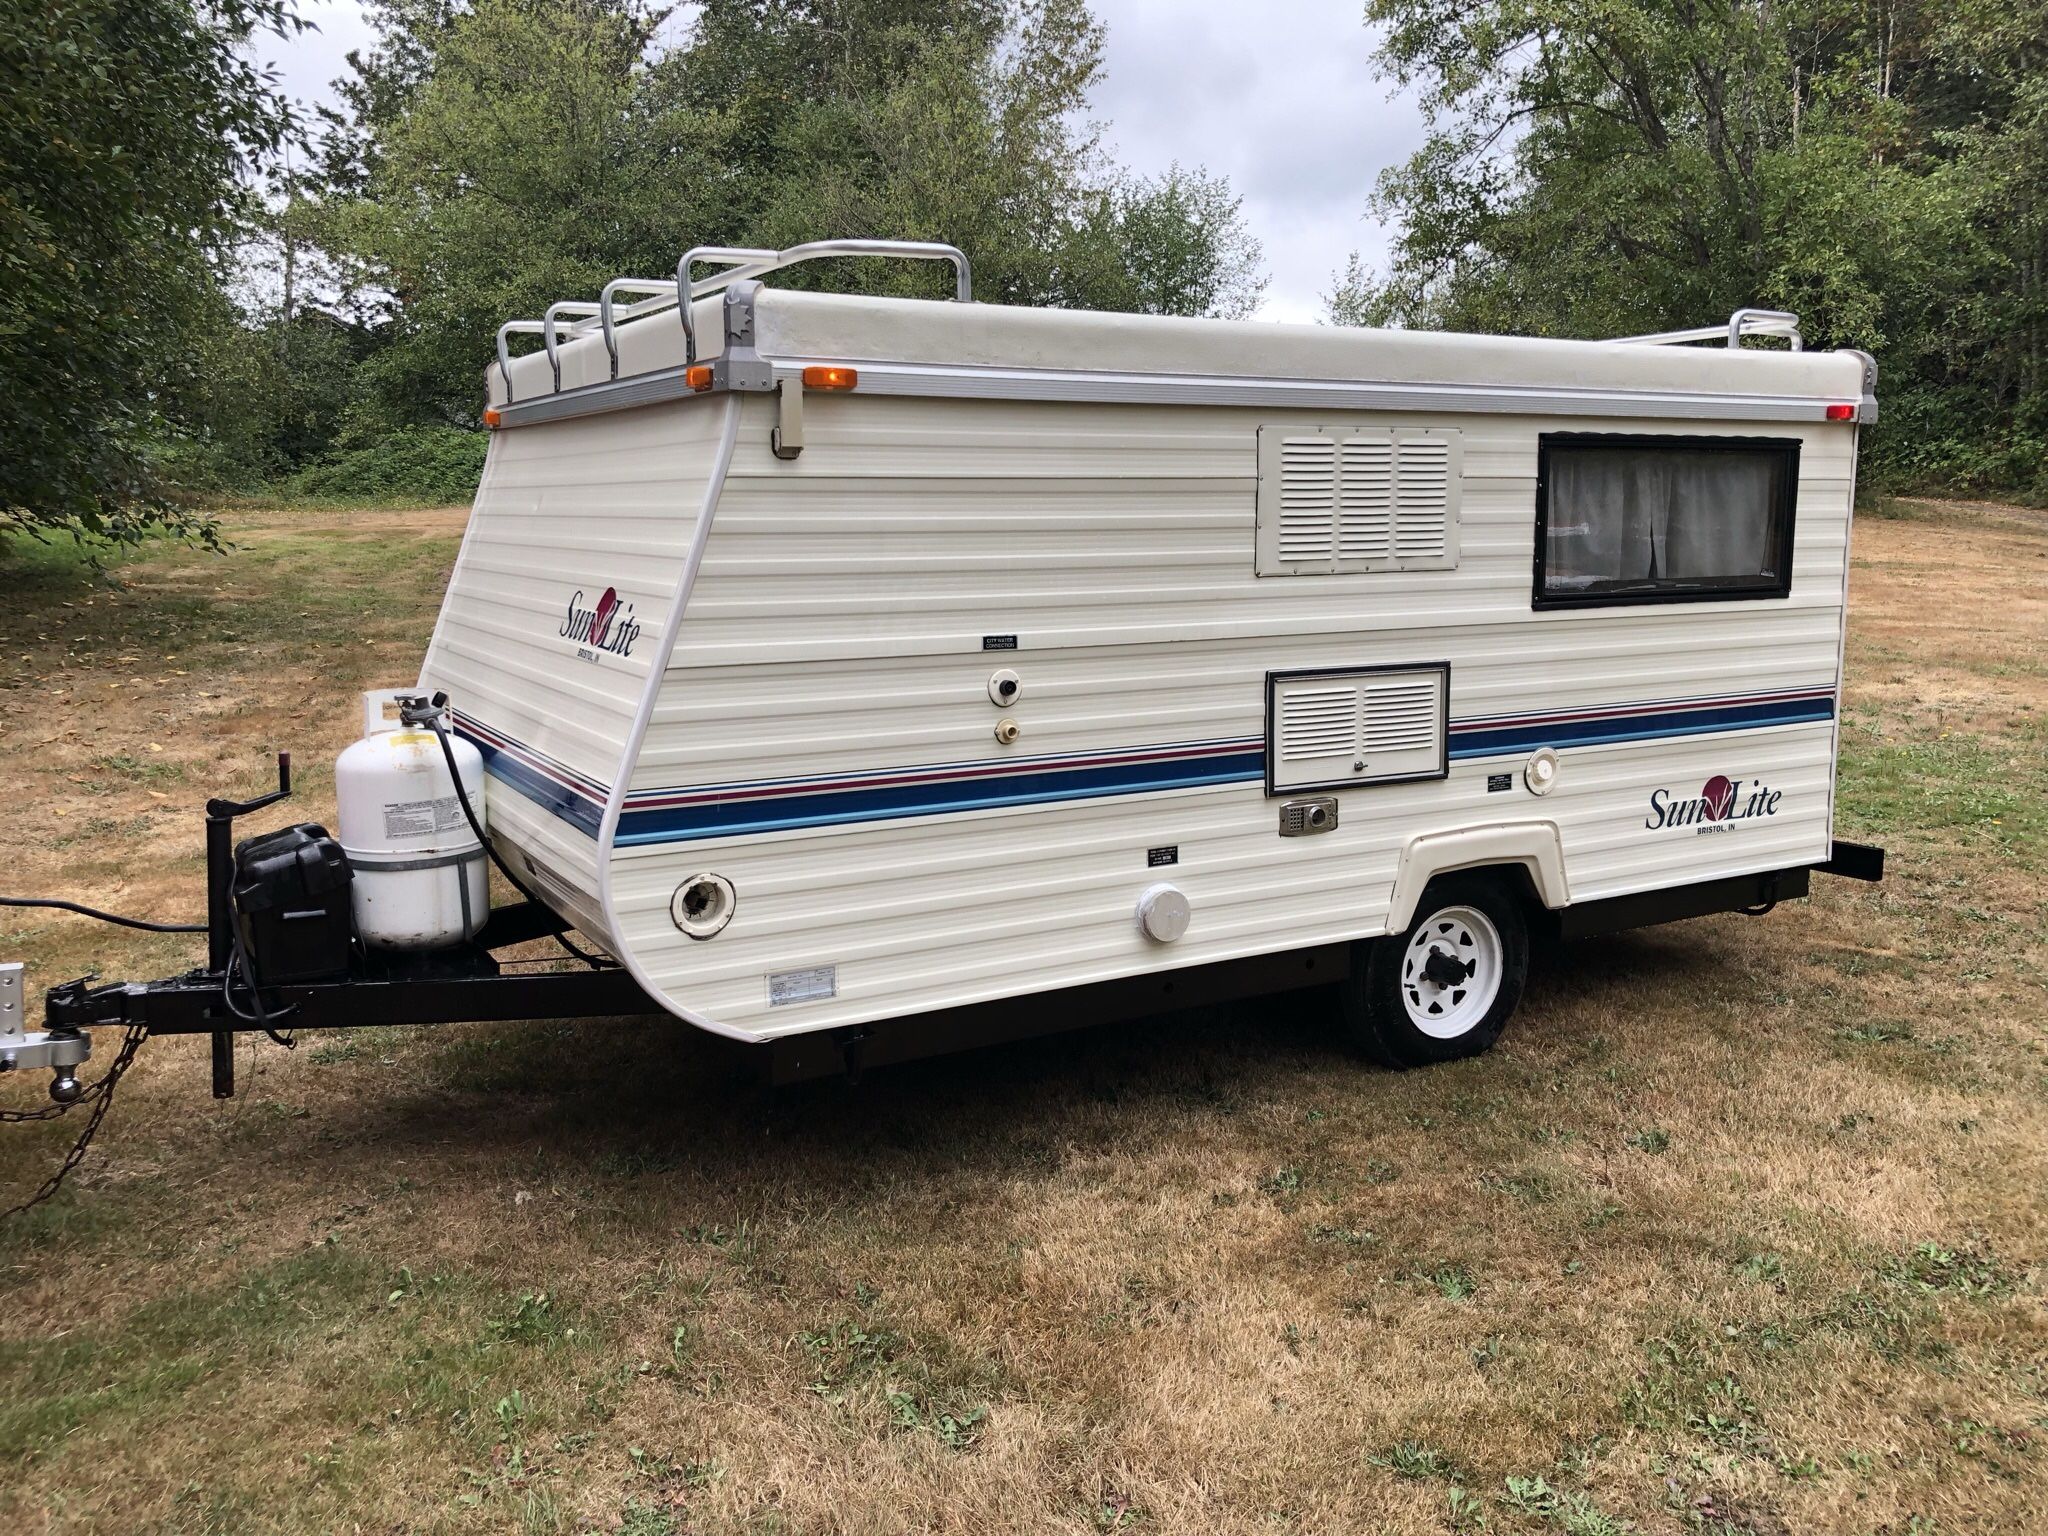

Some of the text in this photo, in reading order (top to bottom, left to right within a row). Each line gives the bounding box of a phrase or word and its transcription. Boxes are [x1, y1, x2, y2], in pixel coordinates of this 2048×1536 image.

[560, 590, 640, 657] Sun Lite
[1645, 780, 1782, 830] Sun Lite
[1697, 823, 1736, 835] BRISTOL, IN
